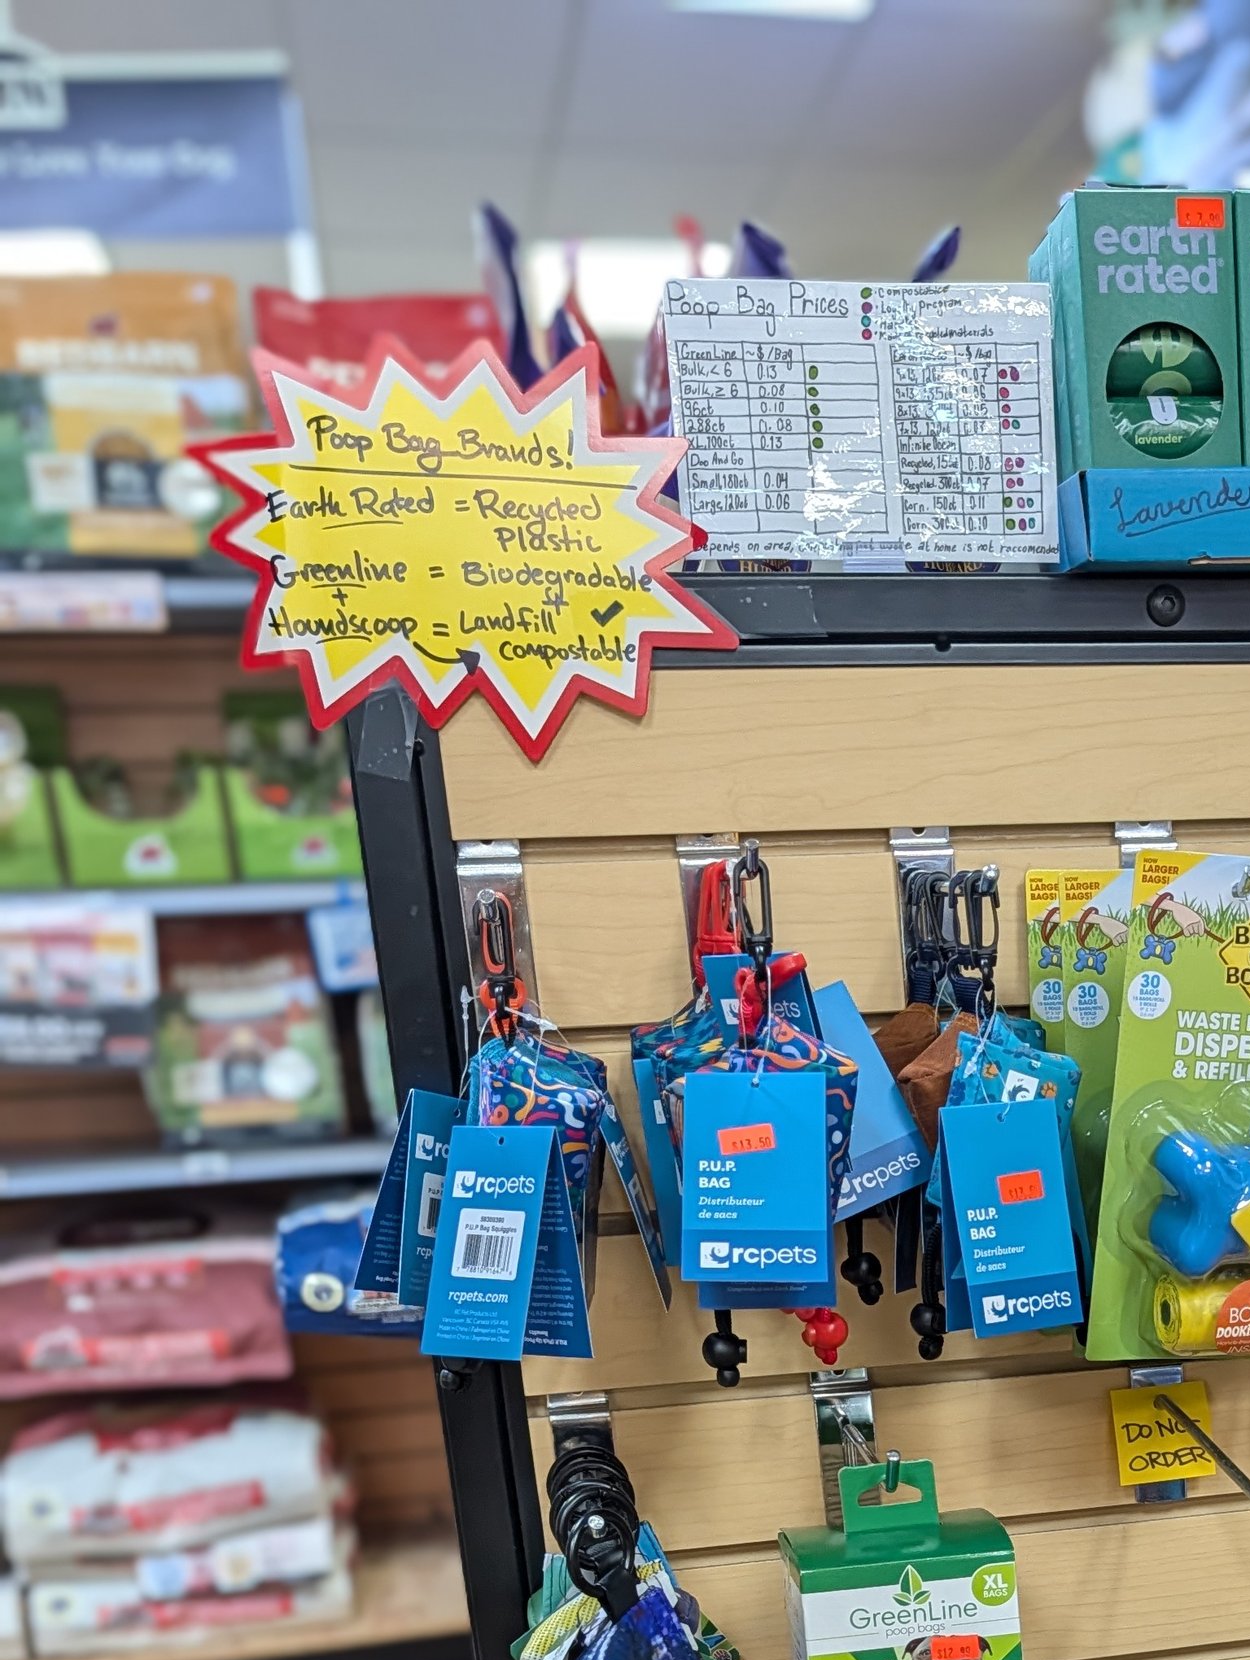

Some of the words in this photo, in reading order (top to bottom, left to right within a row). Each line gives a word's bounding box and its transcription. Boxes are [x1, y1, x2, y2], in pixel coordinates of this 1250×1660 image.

[667, 281, 719, 329] Poop
[737, 286, 775, 337] Bag
[789, 282, 849, 316] Prices
[307, 415, 373, 462] Poop
[383, 422, 446, 473] Bag
[446, 428, 575, 472] Brands!
[1135, 434, 1183, 445] lavender
[266, 487, 344, 523] Earth
[349, 486, 435, 519] Rated
[472, 488, 601, 533] Recycled
[494, 526, 602, 554] Plastic
[918, 542, 930, 551] at
[934, 542, 957, 552] home
[963, 542, 972, 551] is
[977, 542, 994, 553] not
[270, 551, 407, 588] Greenline
[462, 561, 653, 602] Biodegradable
[269, 608, 418, 641] Houndscoop
[459, 602, 558, 635] Landfill
[499, 640, 637, 670] compostable
[1142, 864, 1179, 875] LARGER
[1140, 973, 1161, 989] 30
[1177, 1010, 1241, 1032] WASTE
[1172, 1060, 1188, 1079] &
[699, 1177, 731, 1189] BAG
[853, 1151, 921, 1195] rcpets
[475, 1175, 535, 1199] rcpets
[698, 1196, 765, 1206] Distributeur
[698, 1209, 711, 1219] de
[713, 1211, 738, 1219] sacs
[732, 1243, 817, 1268] rcpets
[448, 1291, 508, 1304] rcpets.com
[1121, 1423, 1153, 1443] DO
[1129, 1447, 1212, 1472] ORDER
[983, 1573, 1008, 1589] XL
[983, 1588, 1008, 1598] BAGS
[850, 1600, 978, 1630] GreenLine
[886, 1623, 916, 1639] poop
[917, 1622, 945, 1634] bags
